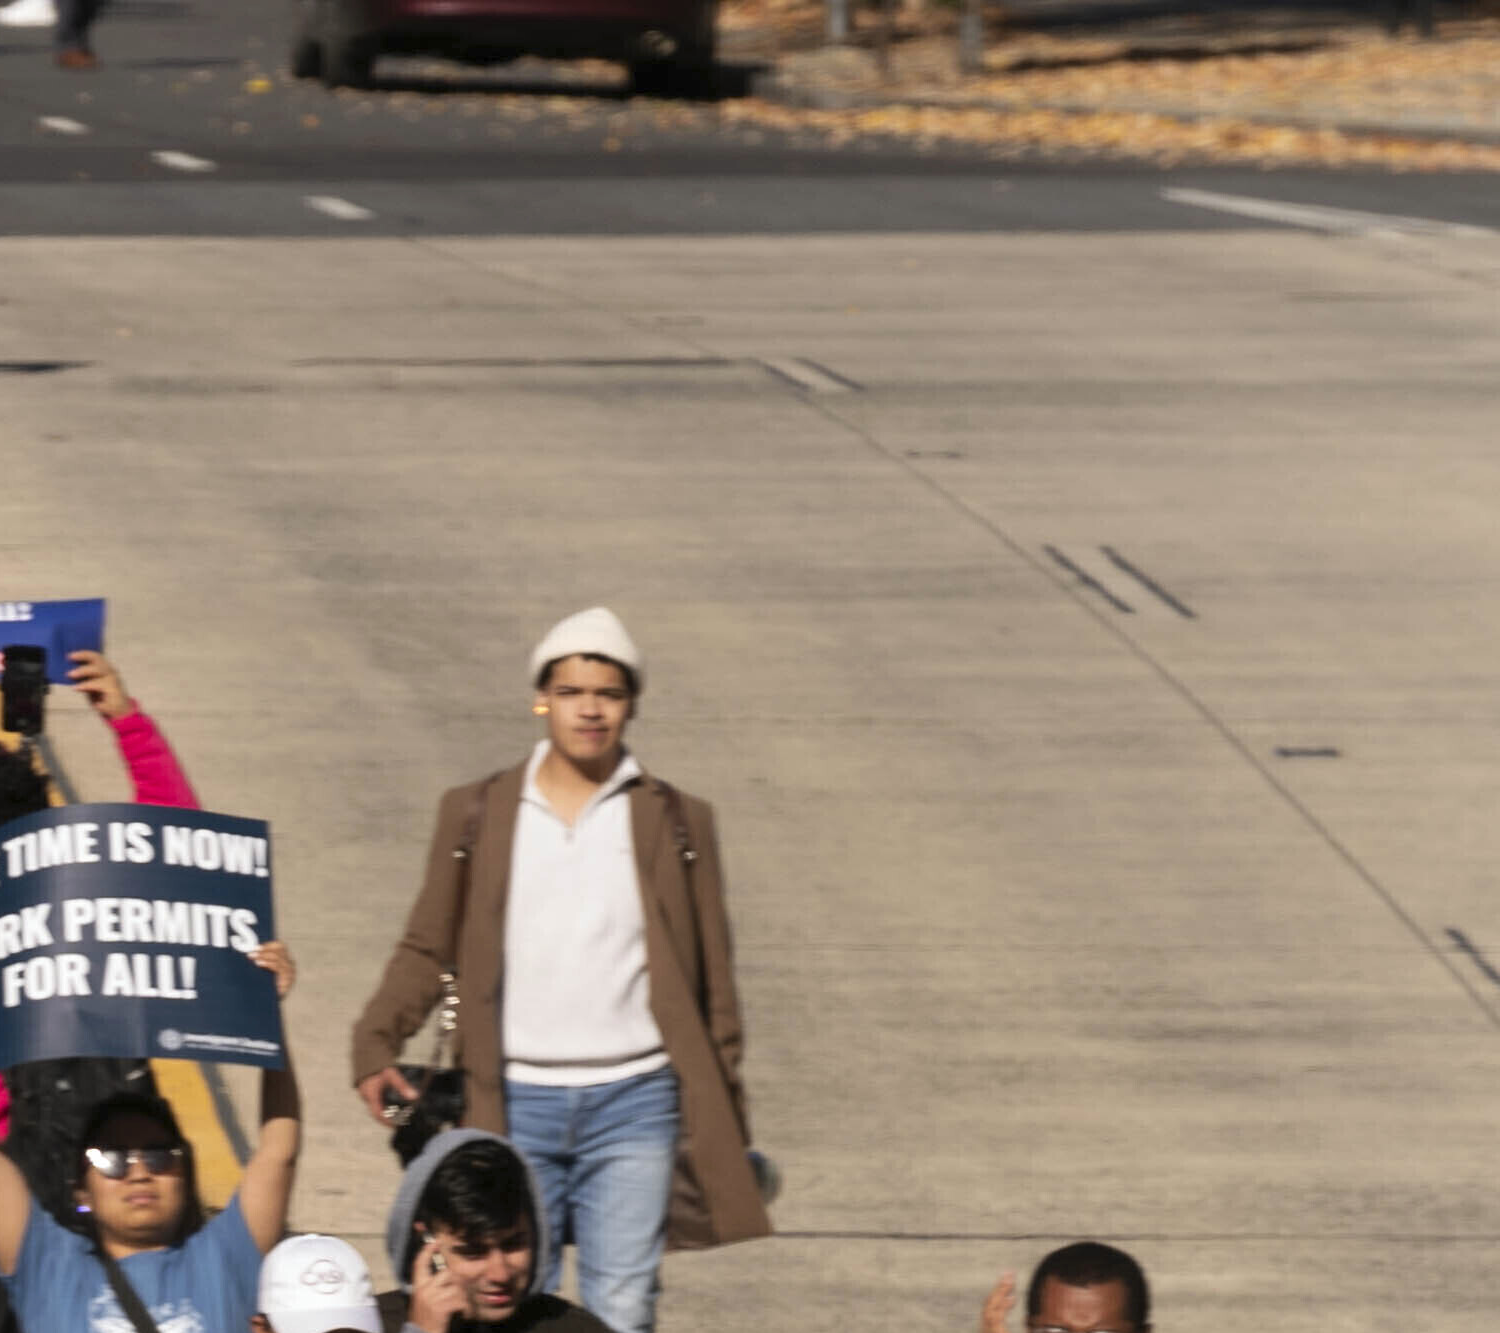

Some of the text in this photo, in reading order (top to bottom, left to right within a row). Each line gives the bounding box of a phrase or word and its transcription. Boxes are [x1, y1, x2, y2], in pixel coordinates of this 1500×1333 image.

[3, 822, 100, 878] TIME
[108, 821, 154, 864] IS
[162, 826, 268, 879] NOW!
[62, 897, 261, 954] PERMITS
[3, 952, 198, 1008] FOR ALL!
